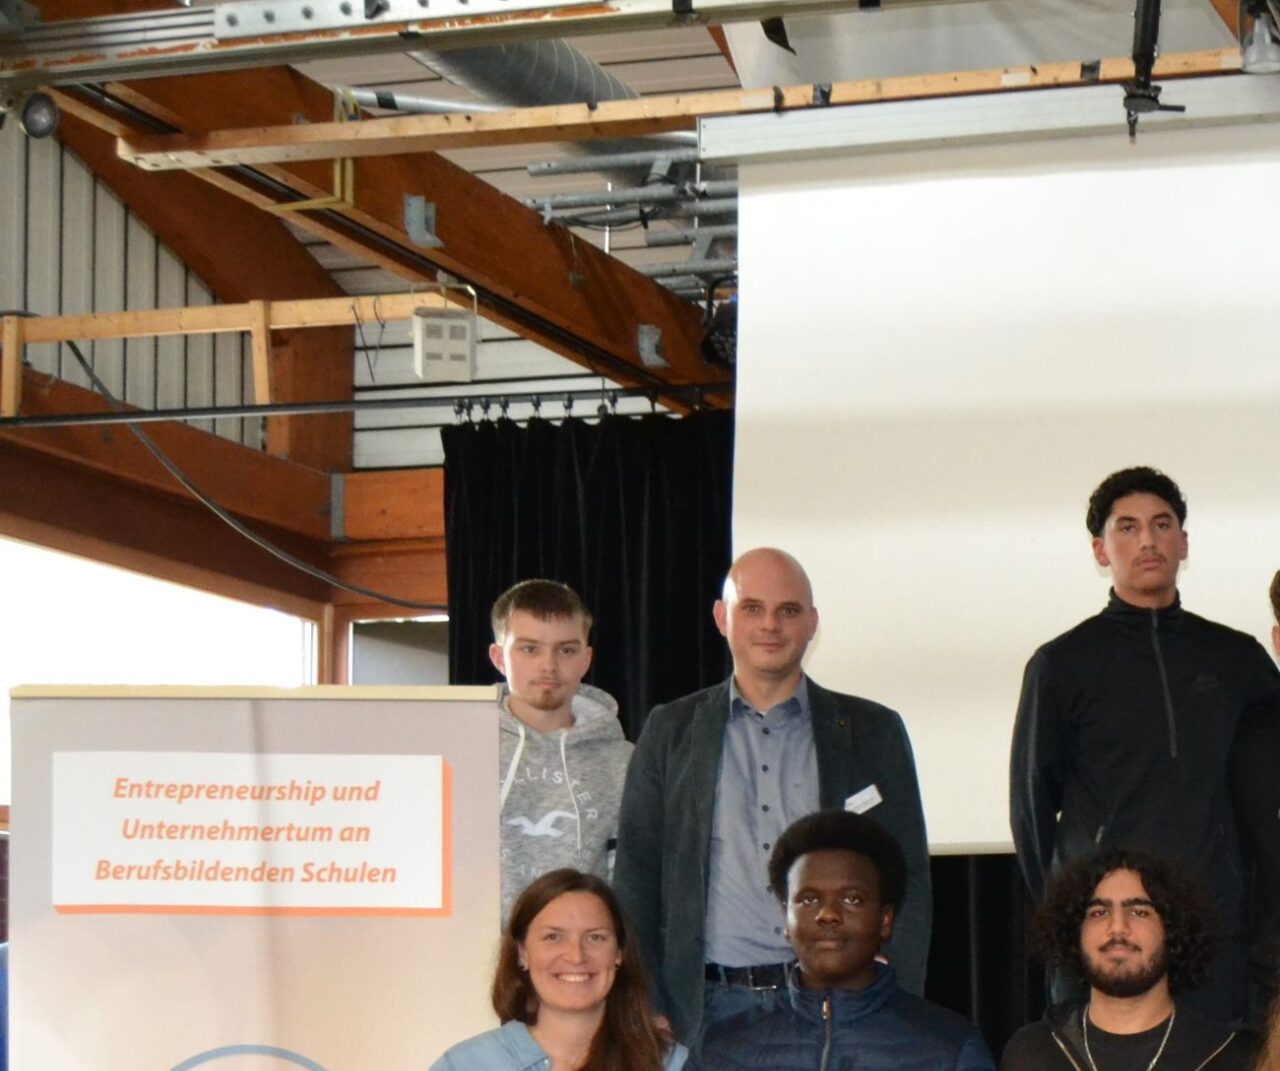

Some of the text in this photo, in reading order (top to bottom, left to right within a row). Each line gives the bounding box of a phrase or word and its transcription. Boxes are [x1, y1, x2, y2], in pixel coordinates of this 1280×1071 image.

[112, 776, 381, 806] Entrepreneurship und
[121, 818, 371, 843] Unternehmertum an
[94, 858, 397, 884] Berufsbildenden Schulen
